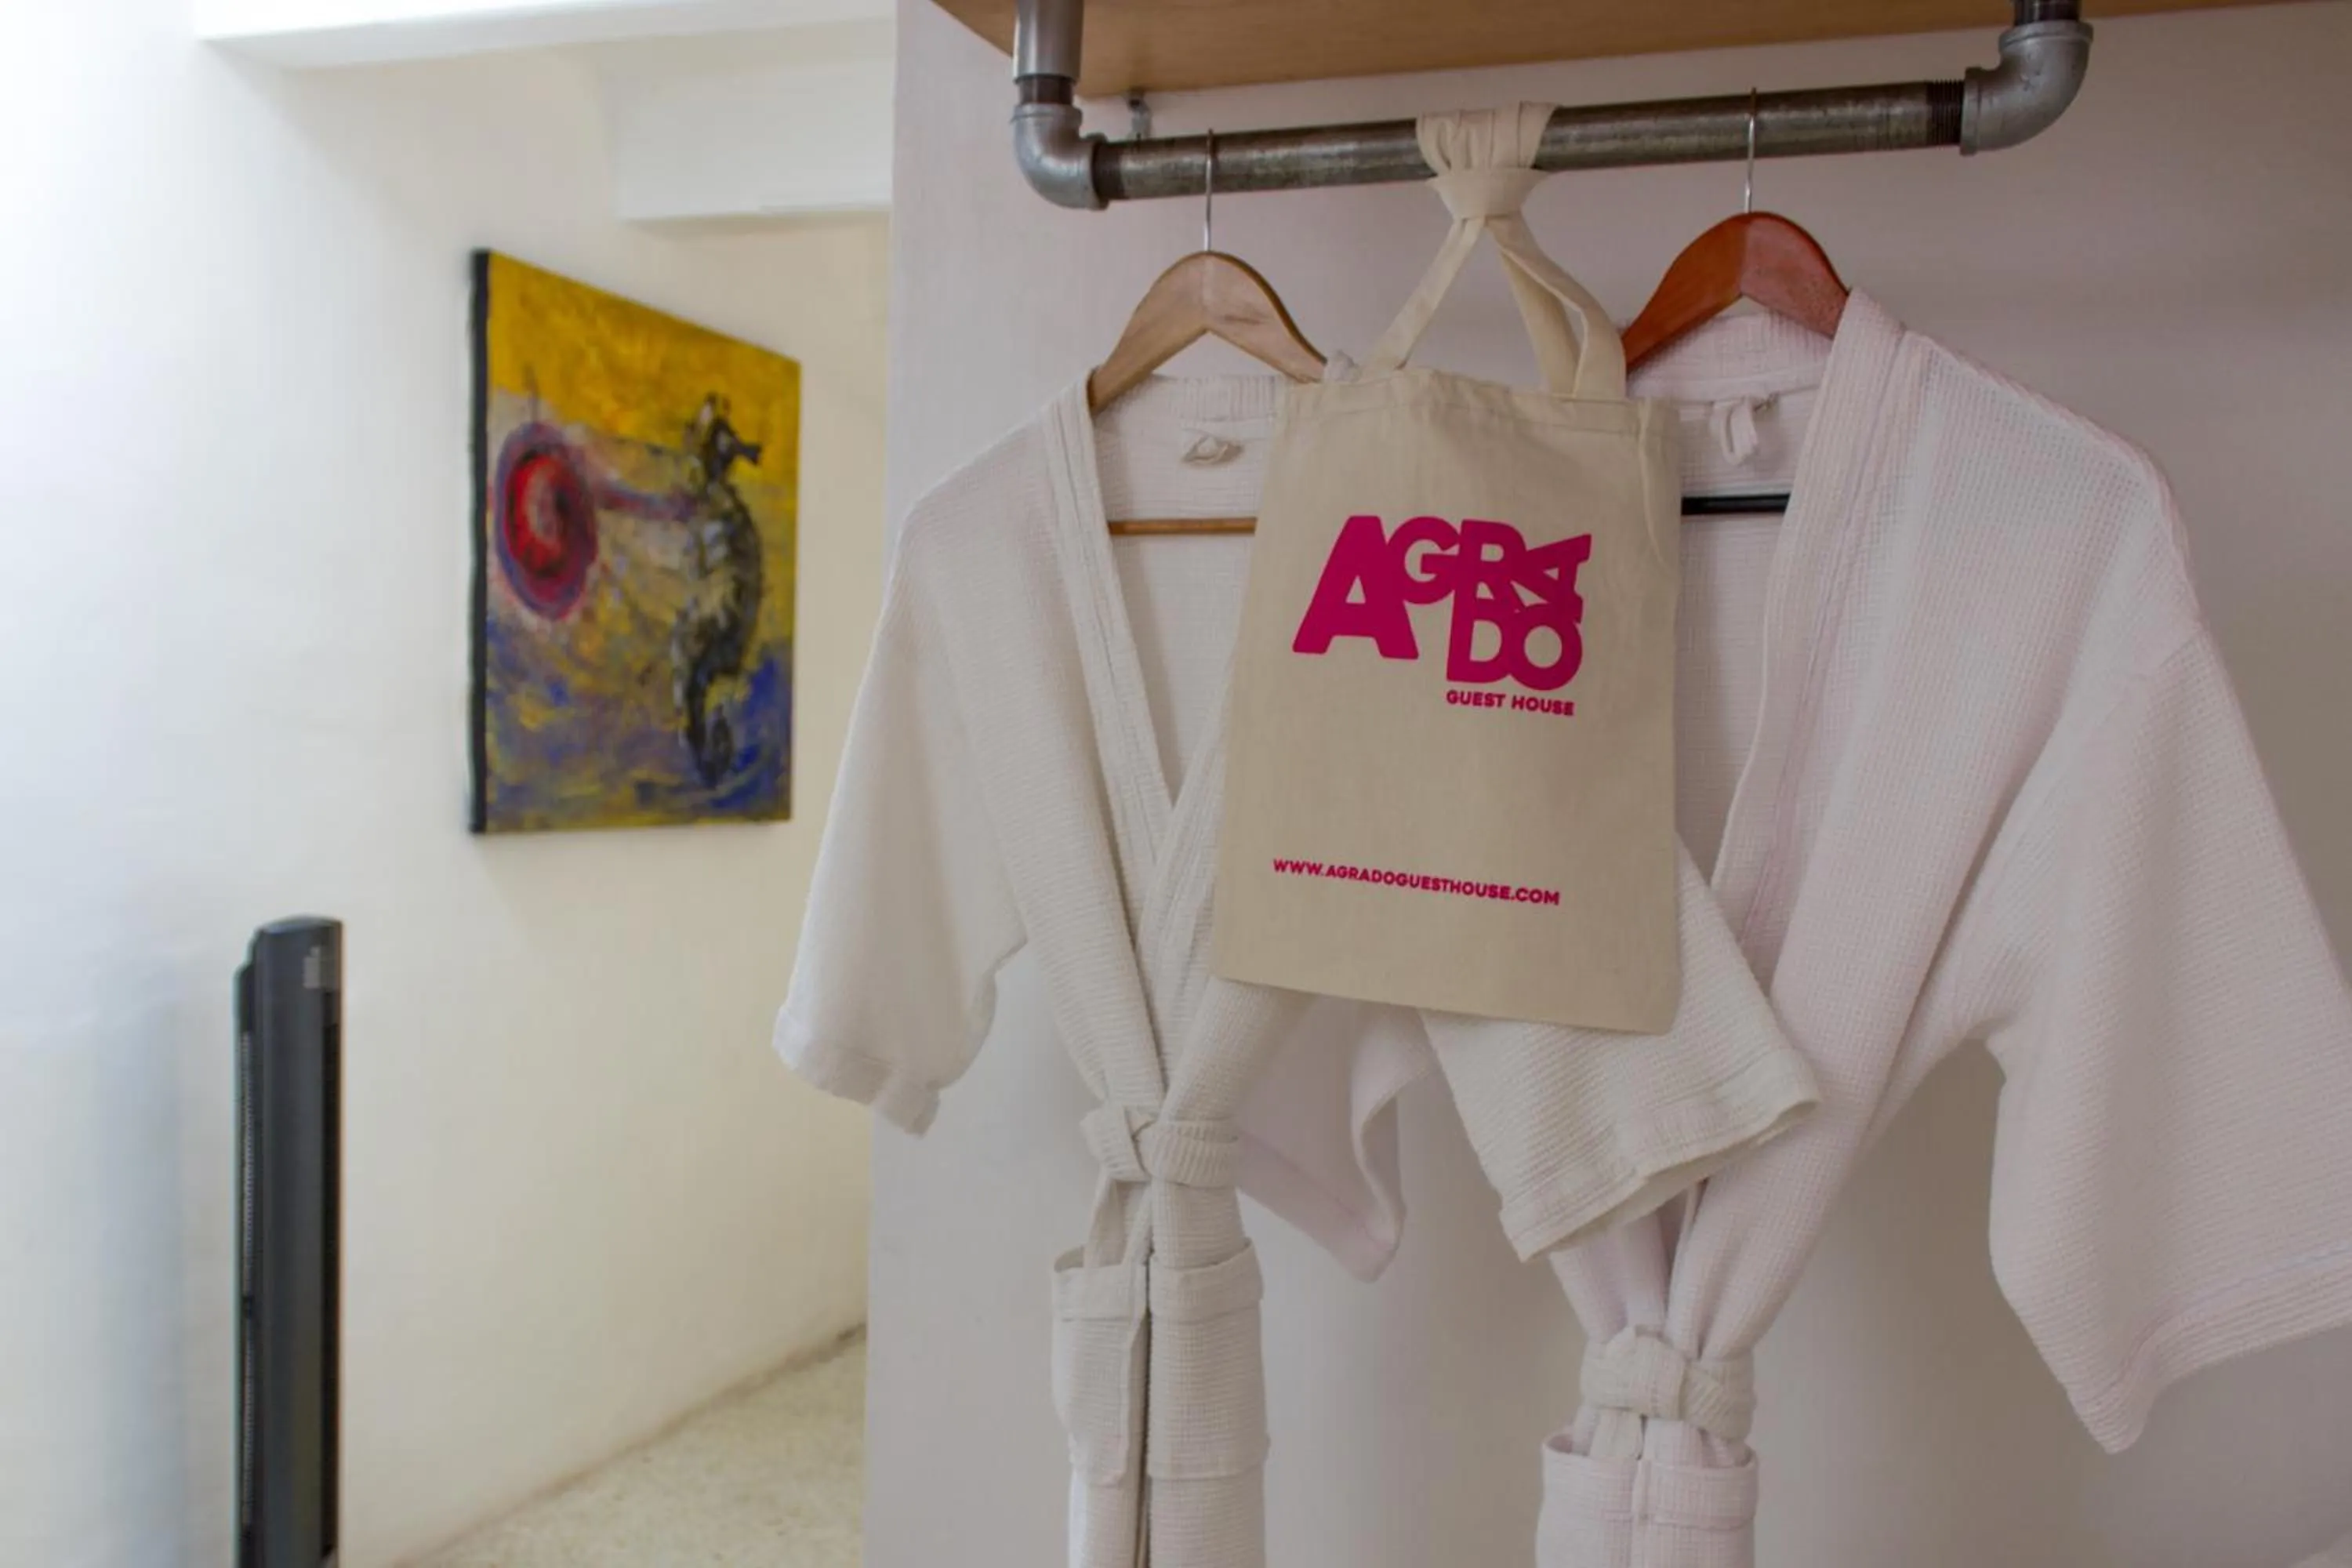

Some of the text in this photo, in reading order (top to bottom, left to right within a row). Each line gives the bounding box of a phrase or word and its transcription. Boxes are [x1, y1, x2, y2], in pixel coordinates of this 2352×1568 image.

[1446, 690, 1575, 717] GUEST HOUSE
[1273, 858, 1560, 906] WWW.AGRADOGUESTHOUSE.COM
